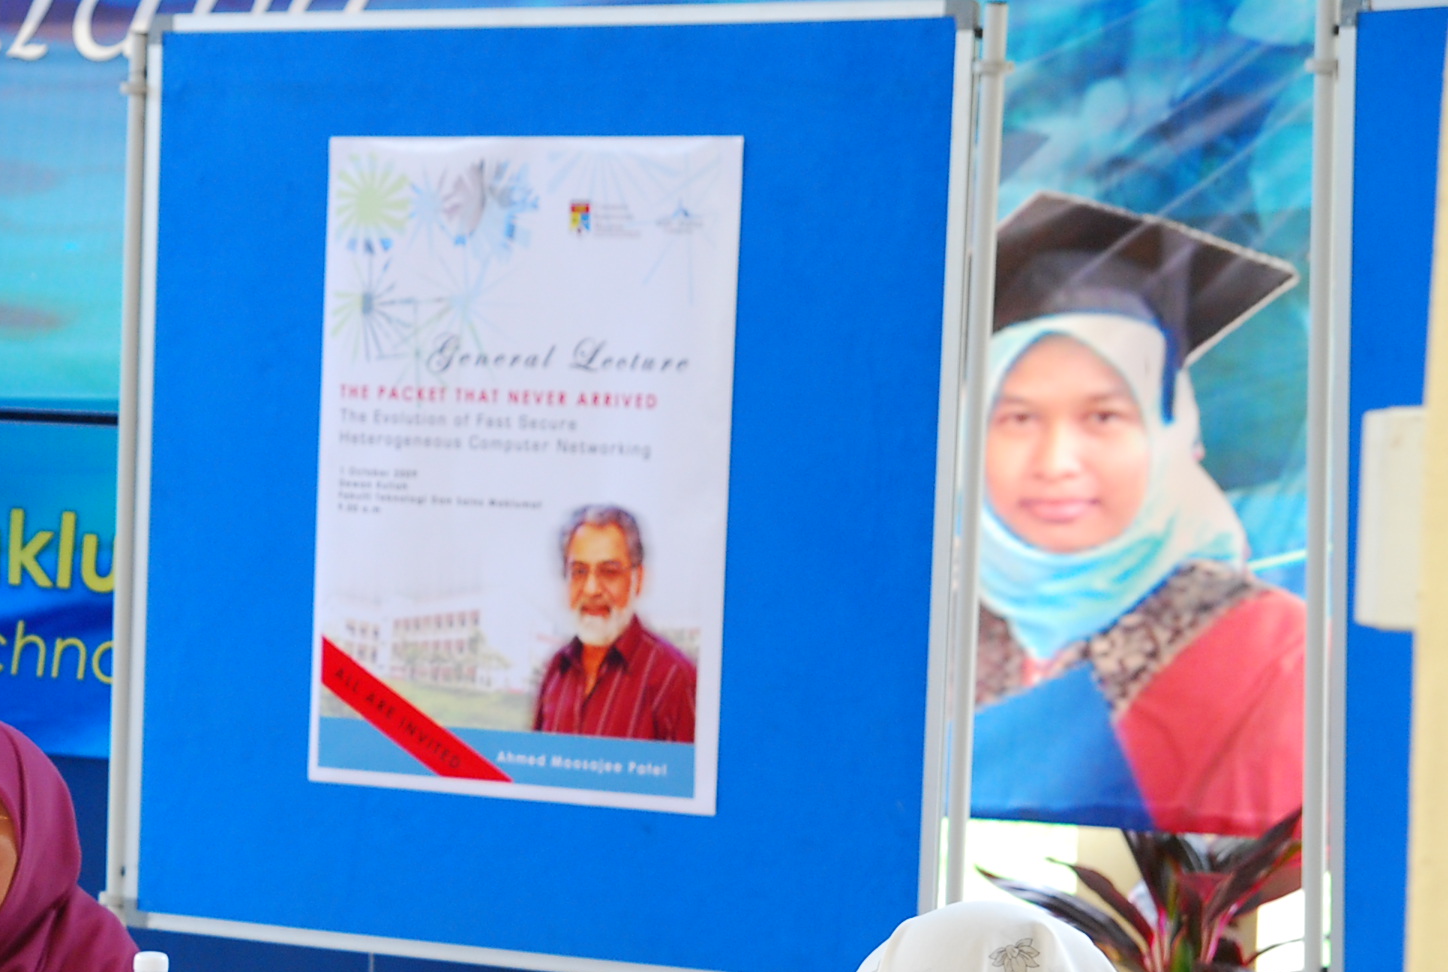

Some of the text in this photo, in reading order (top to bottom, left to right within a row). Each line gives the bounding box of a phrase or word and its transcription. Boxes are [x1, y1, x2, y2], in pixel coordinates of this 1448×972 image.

[425, 332, 689, 374] General Lecture
[340, 383, 657, 410] THE PACKET THAT NEVER ARRIVED
[340, 407, 577, 430] The Evolution of Fast Secure
[339, 430, 651, 461] Heterogeneous Computer Networking
[335, 668, 462, 769] ALL ARE INVITED
[496, 751, 668, 777] Ahmed Moosajee Patel
